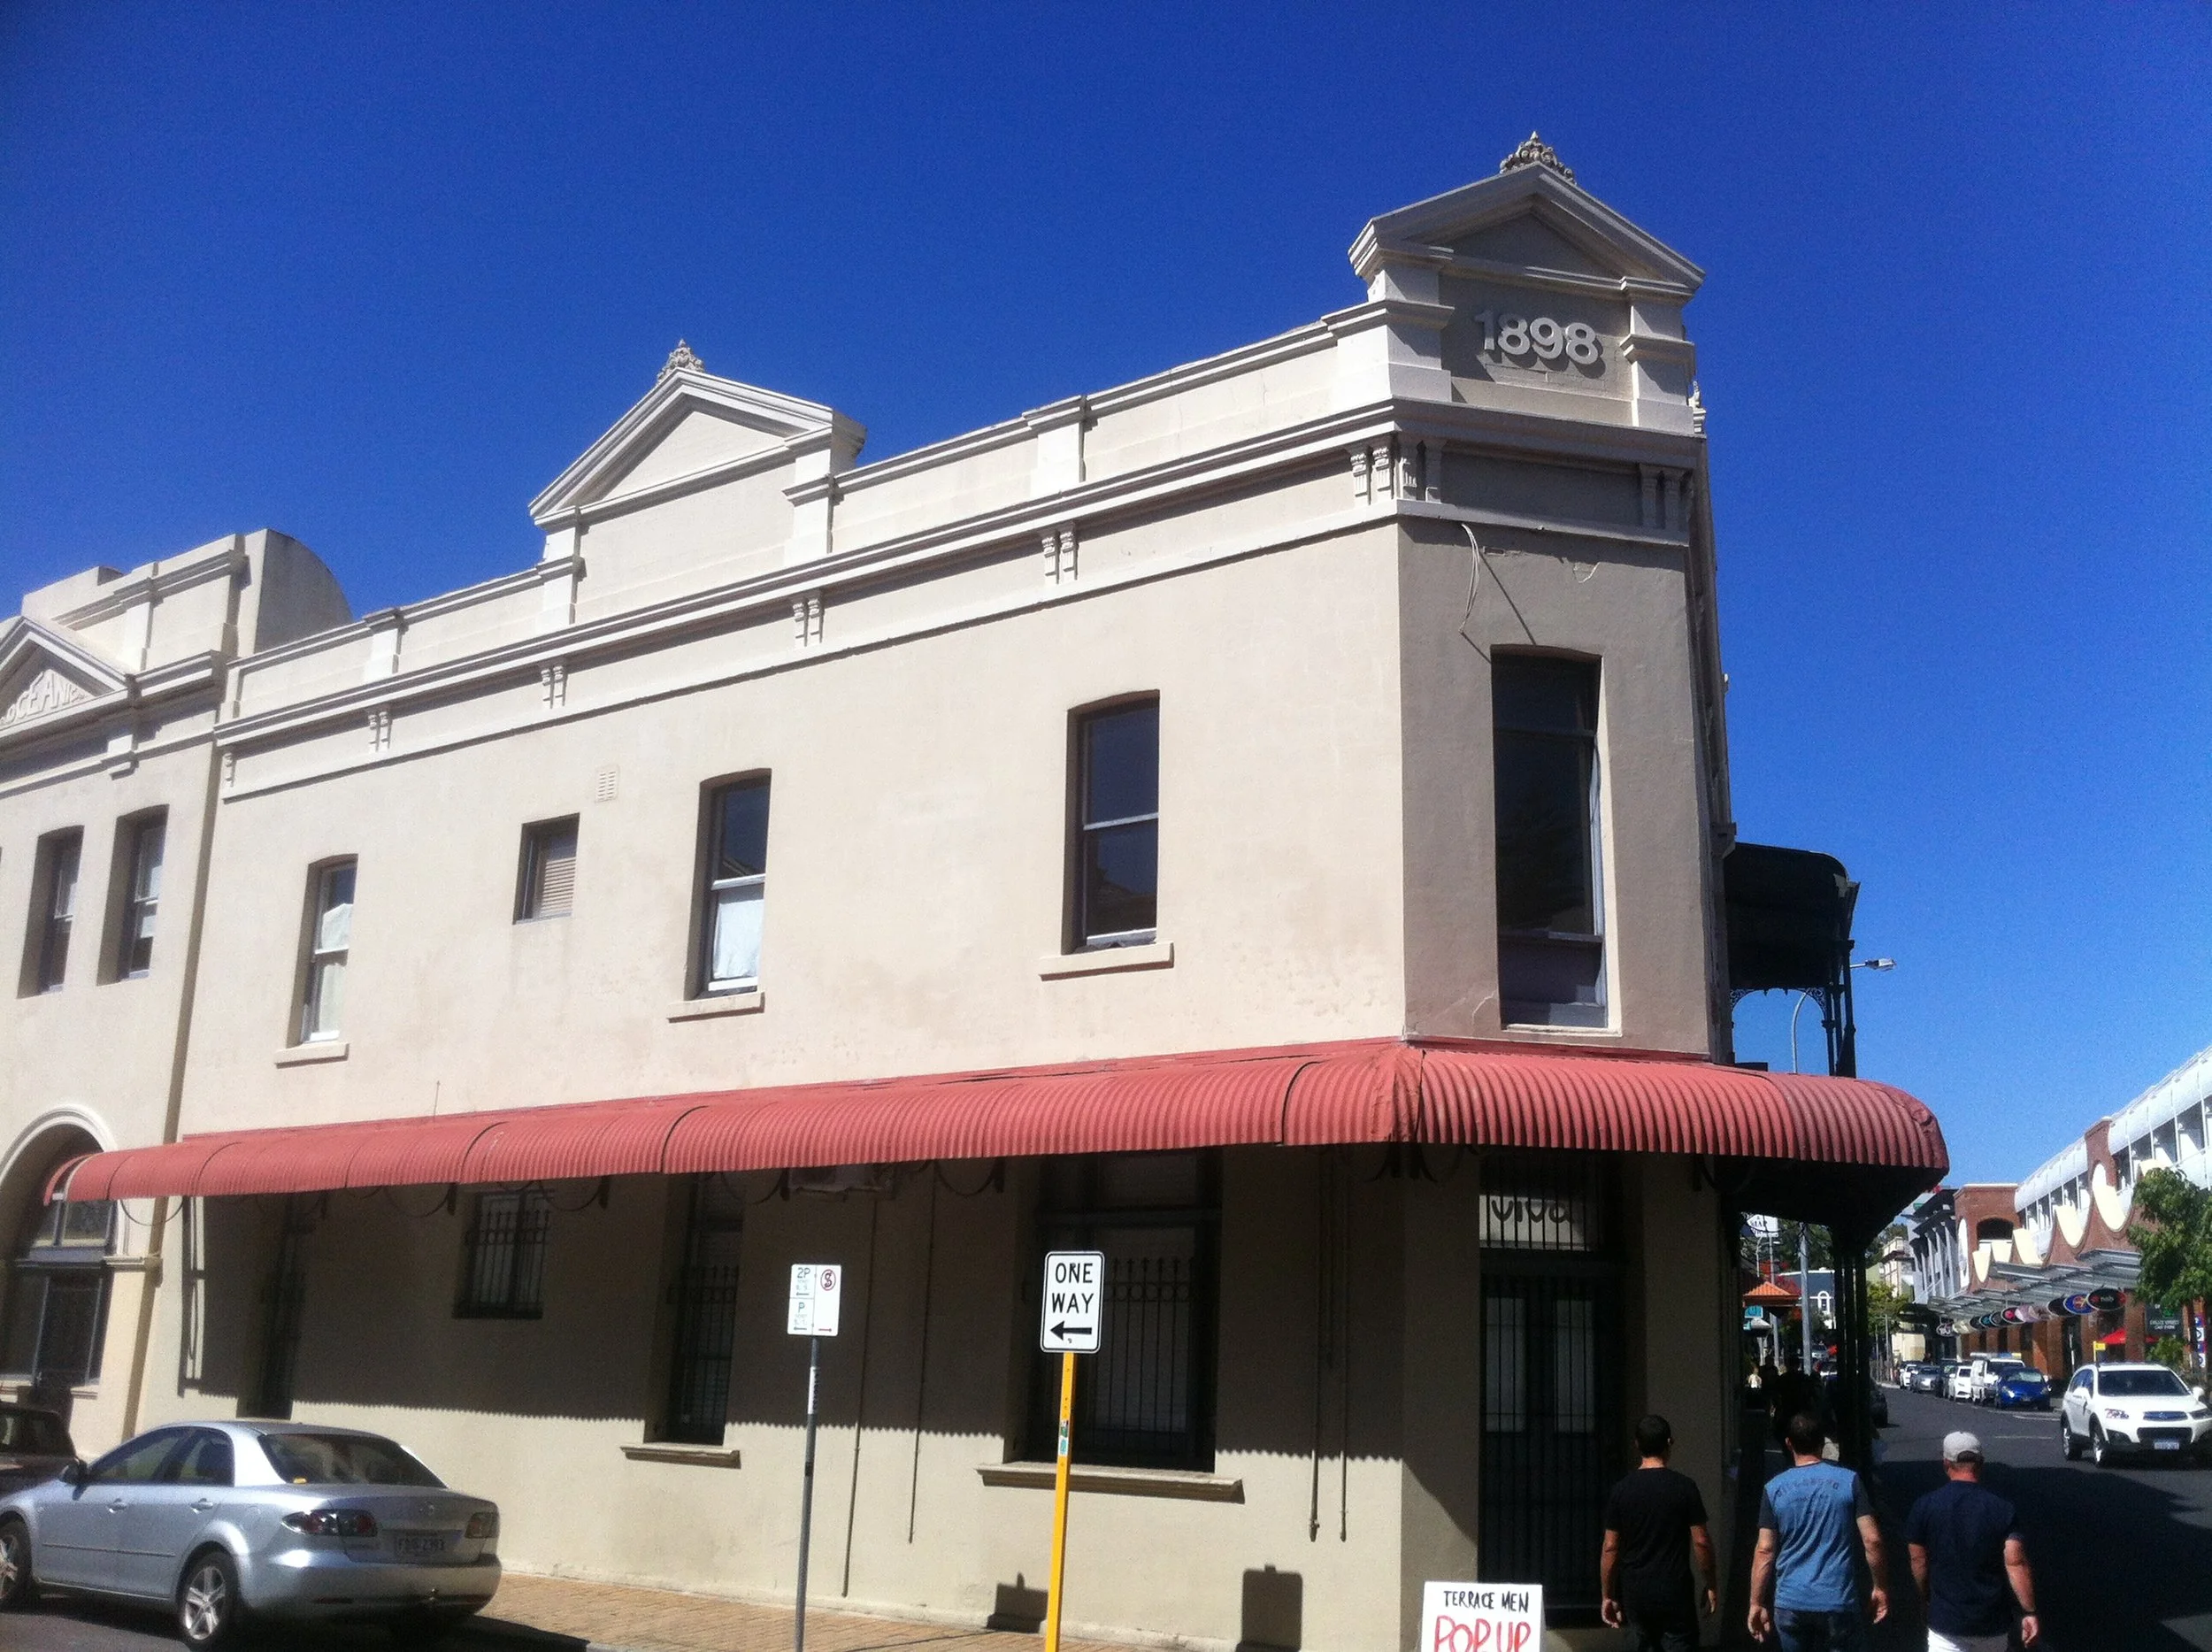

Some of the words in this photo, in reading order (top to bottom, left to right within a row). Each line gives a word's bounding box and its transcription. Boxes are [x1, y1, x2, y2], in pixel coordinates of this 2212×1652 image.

[1473, 311, 1599, 365] 1898
[797, 1267, 811, 1279] 2P
[1055, 1263, 1094, 1284] ONE
[798, 1302, 805, 1313] P
[1051, 1293, 1094, 1314] WAY
[1443, 1590, 1495, 1610] TERRACE
[1501, 1591, 1530, 1613] MEN
